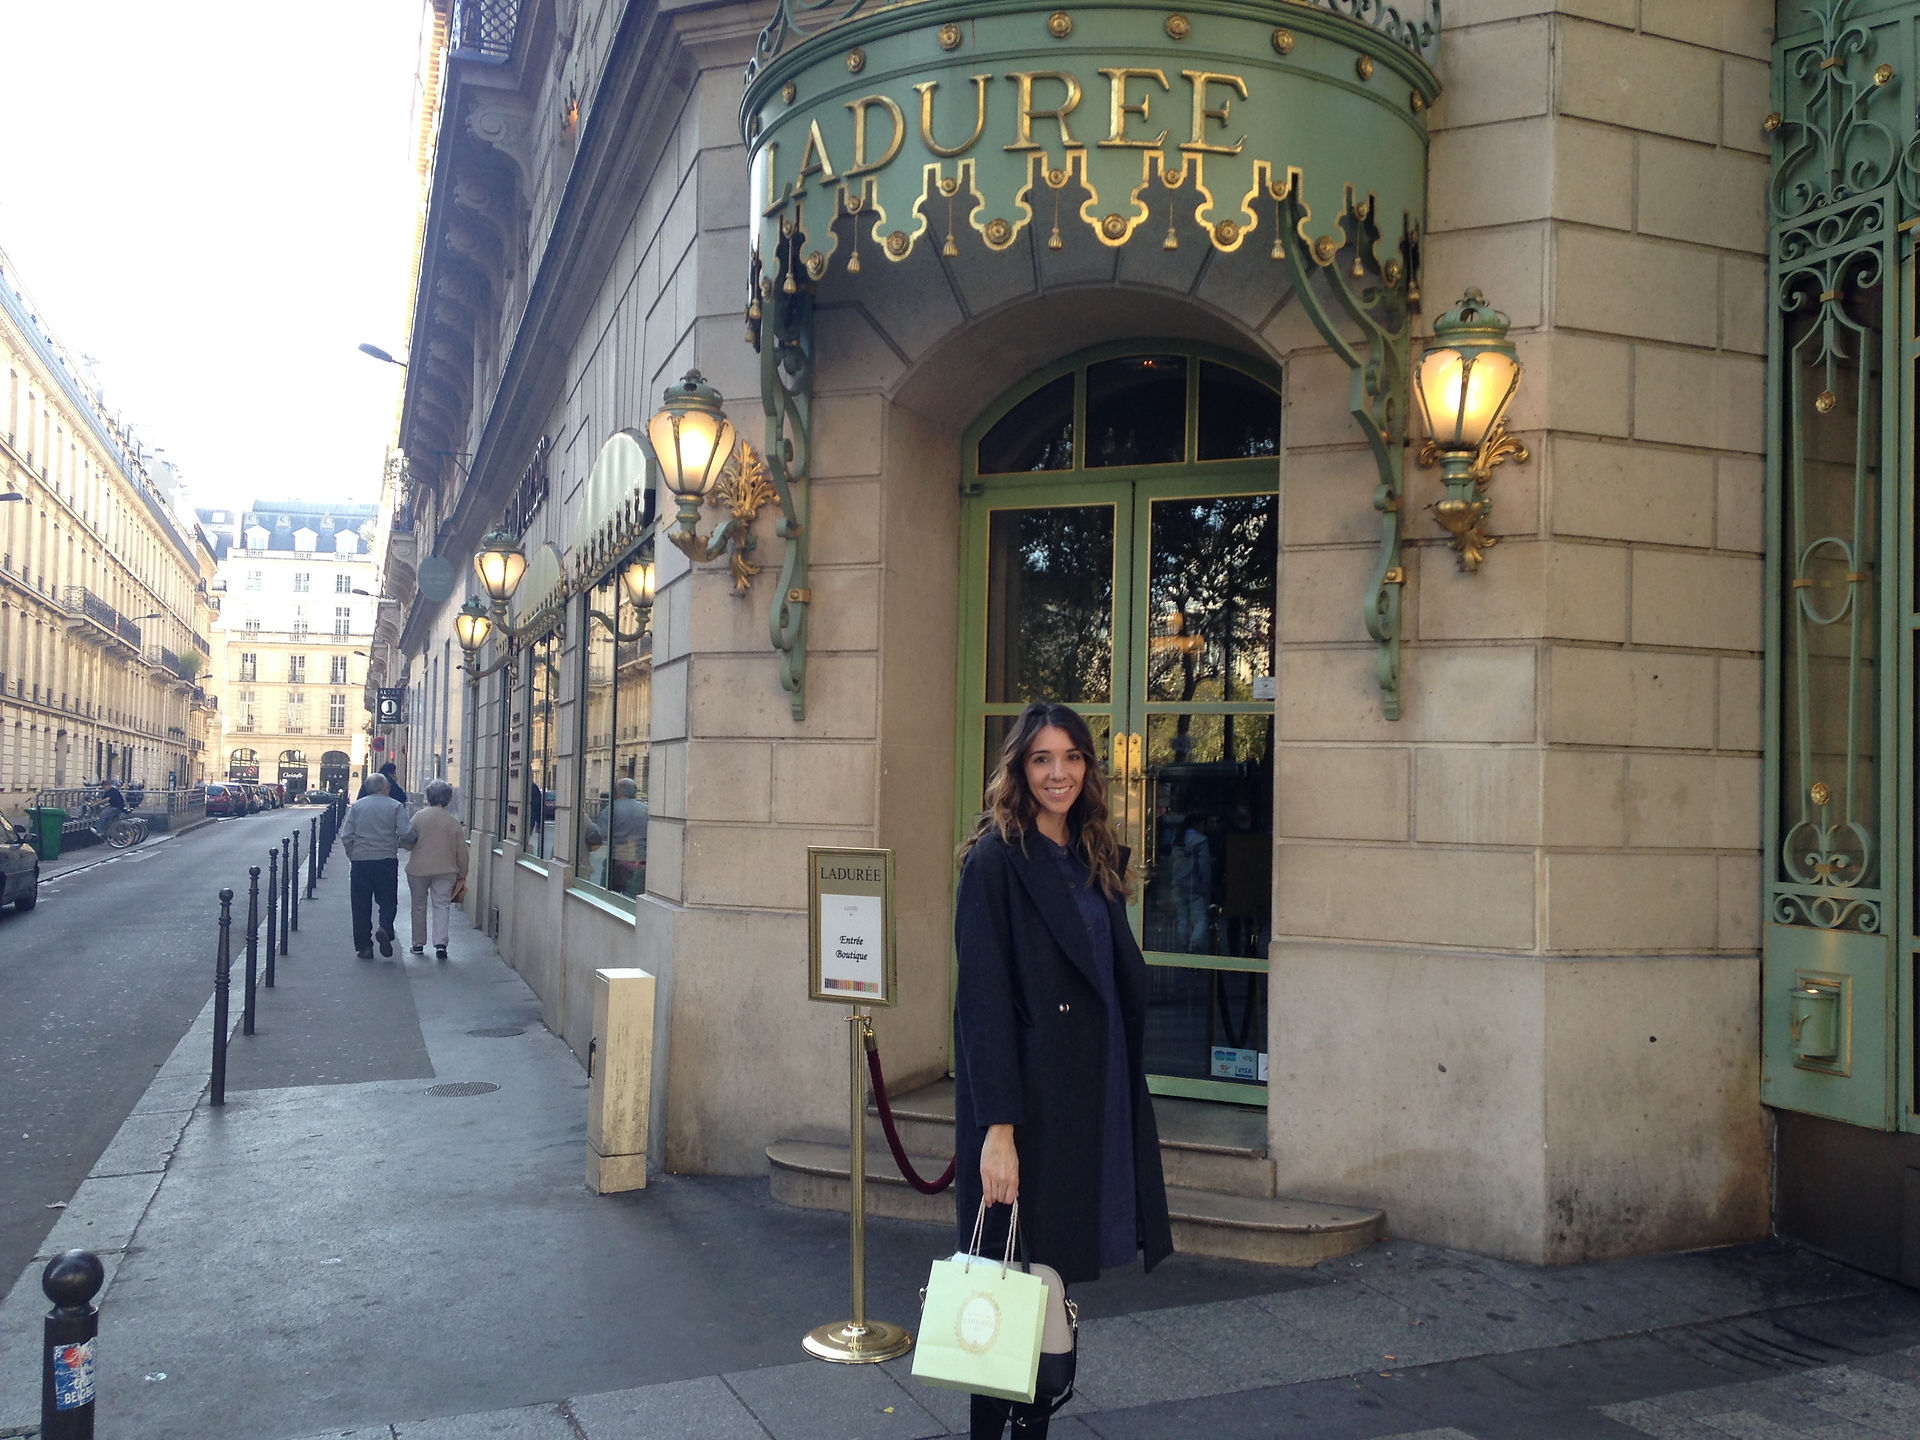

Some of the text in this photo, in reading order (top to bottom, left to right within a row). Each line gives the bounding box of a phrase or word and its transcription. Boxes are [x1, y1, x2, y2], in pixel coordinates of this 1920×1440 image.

[762, 67, 1249, 217] LADUREE
[820, 866, 882, 882] LADURÉE
[839, 935, 864, 946] Entrée
[835, 949, 868, 963] Boutique
[1238, 1066, 1252, 1074] VISA
